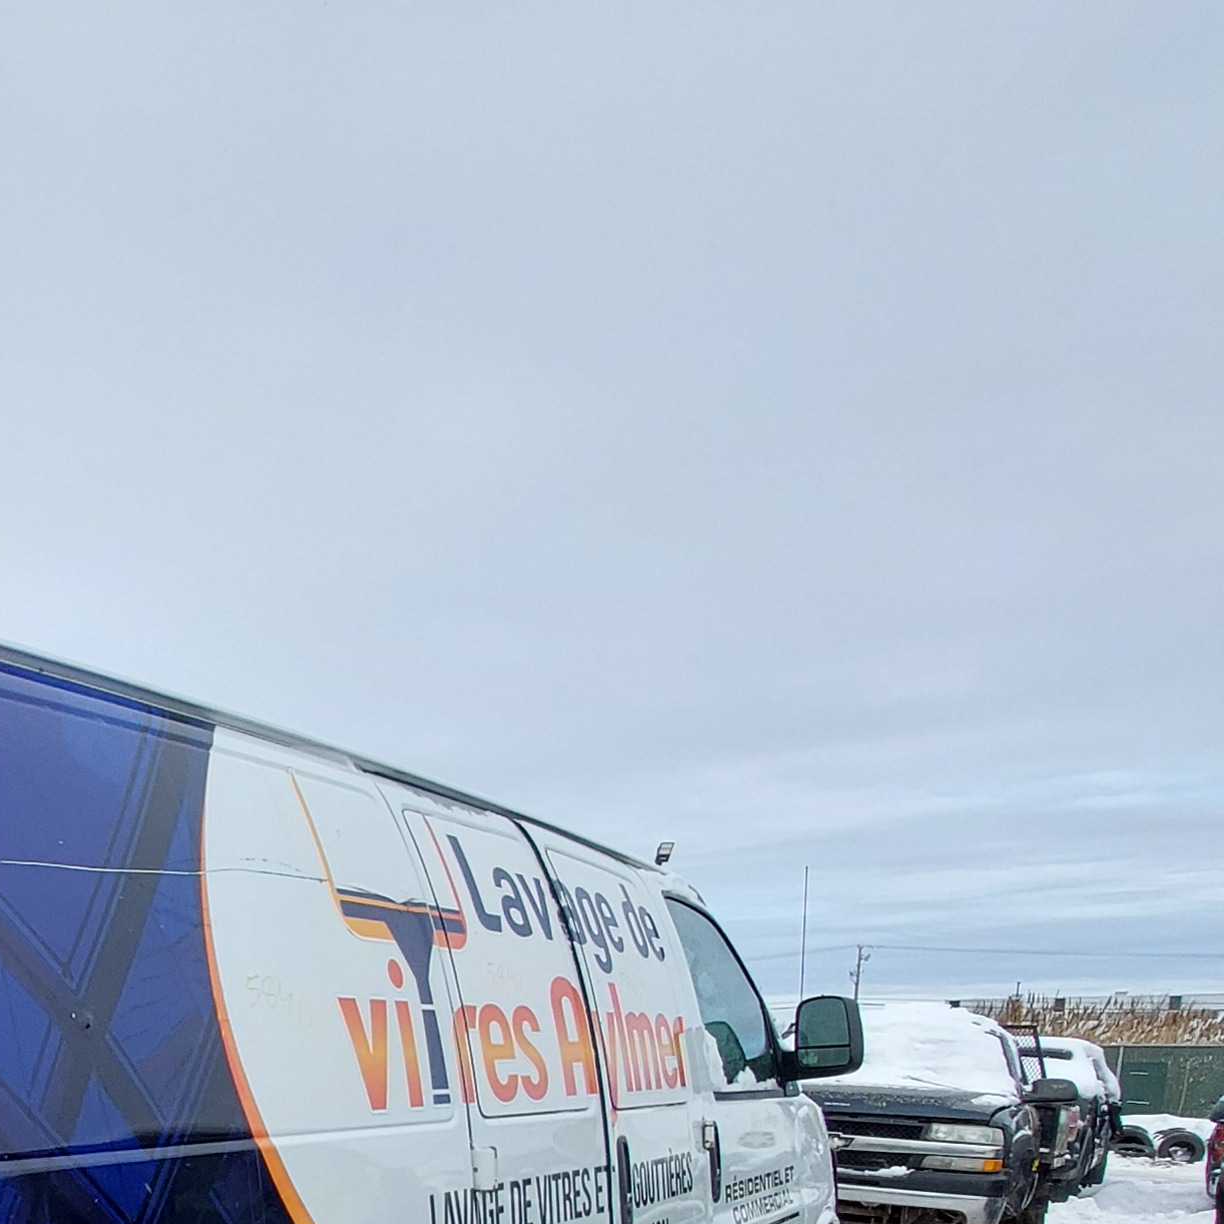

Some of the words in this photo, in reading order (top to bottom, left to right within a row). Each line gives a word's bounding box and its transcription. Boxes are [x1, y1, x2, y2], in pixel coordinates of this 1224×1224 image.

[446, 834, 624, 974] Lavage
[620, 884, 666, 963] de
[549, 976, 687, 1128] Aylmer
[631, 1148, 694, 1210] GOUTTIÈRES
[784, 1165, 795, 1184] ET
